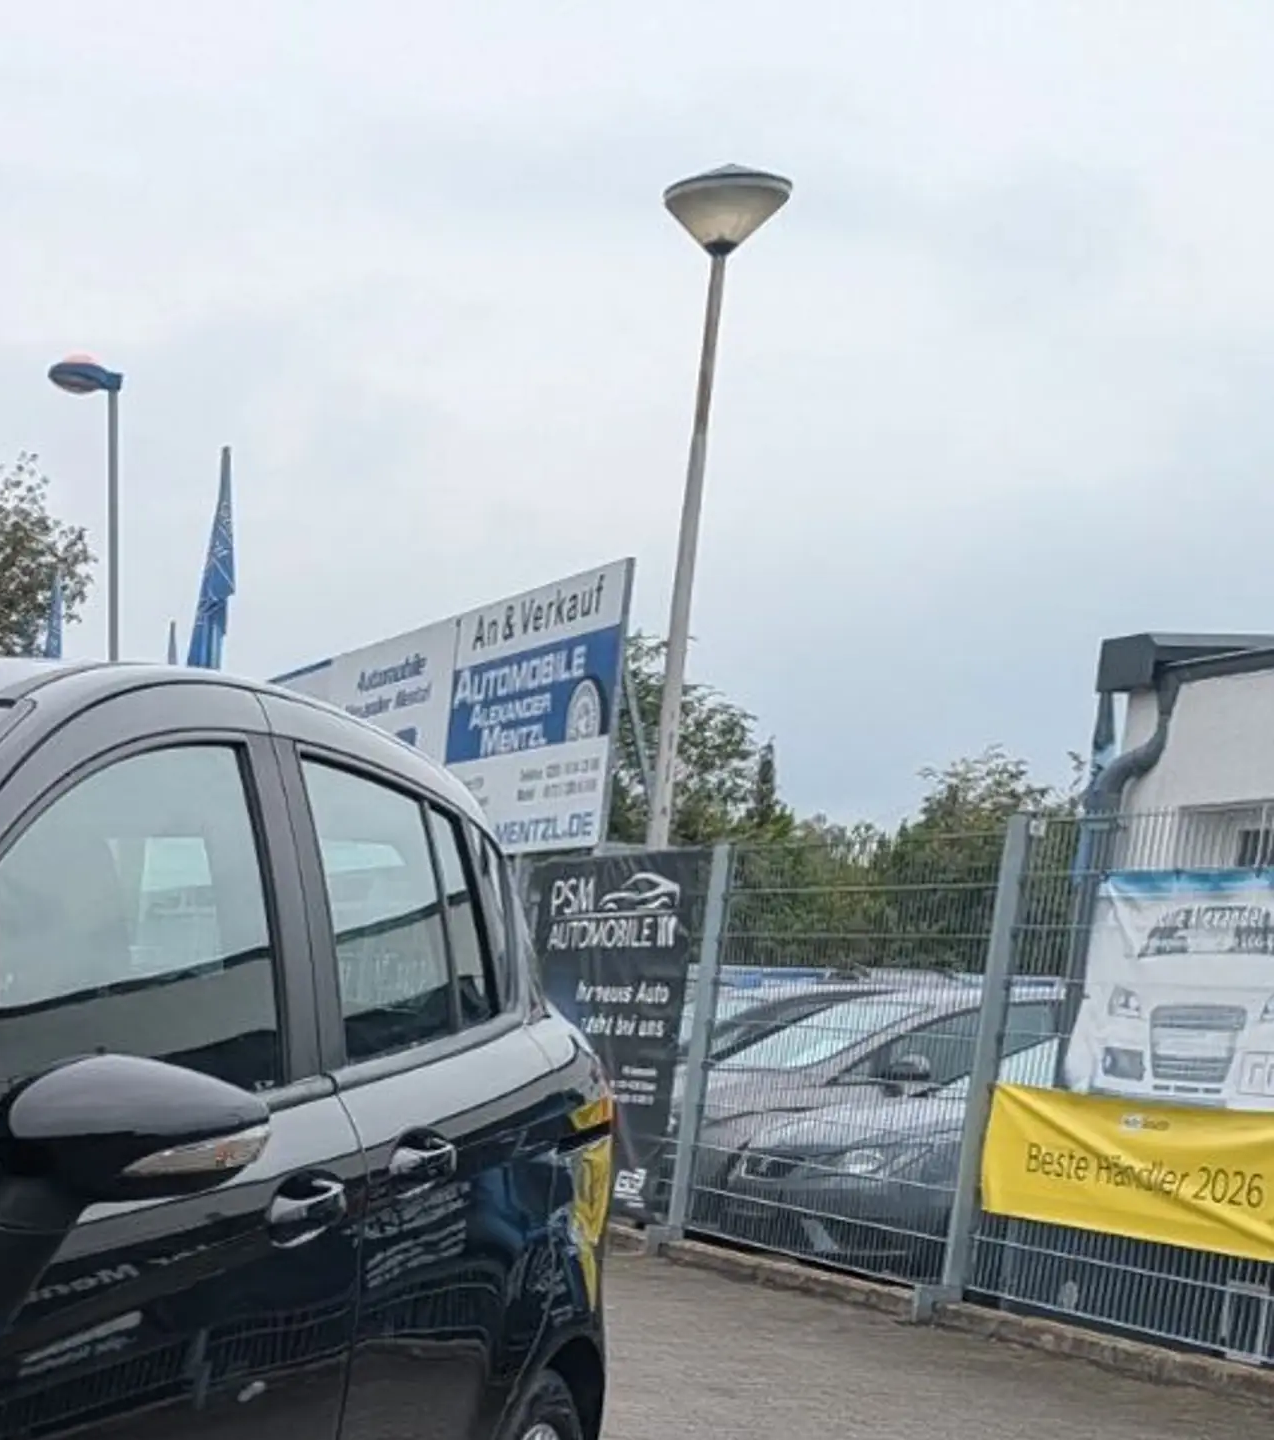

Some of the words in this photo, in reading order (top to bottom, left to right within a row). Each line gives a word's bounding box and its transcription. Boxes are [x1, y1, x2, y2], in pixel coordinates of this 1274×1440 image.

[472, 614, 499, 651] An
[502, 605, 516, 641] &
[520, 574, 606, 635] Verkauf
[454, 645, 587, 709] AUTOMOBILE
[469, 692, 552, 730] ALEXANDER
[479, 723, 548, 757] MENTZL
[550, 877, 596, 917] PSM
[547, 917, 654, 950] AUTOMOBILE
[635, 981, 671, 1004] Auto
[1026, 1142, 1091, 1182] Beste
[1094, 1153, 1191, 1202] Händler
[1192, 1165, 1265, 1209] 2026
